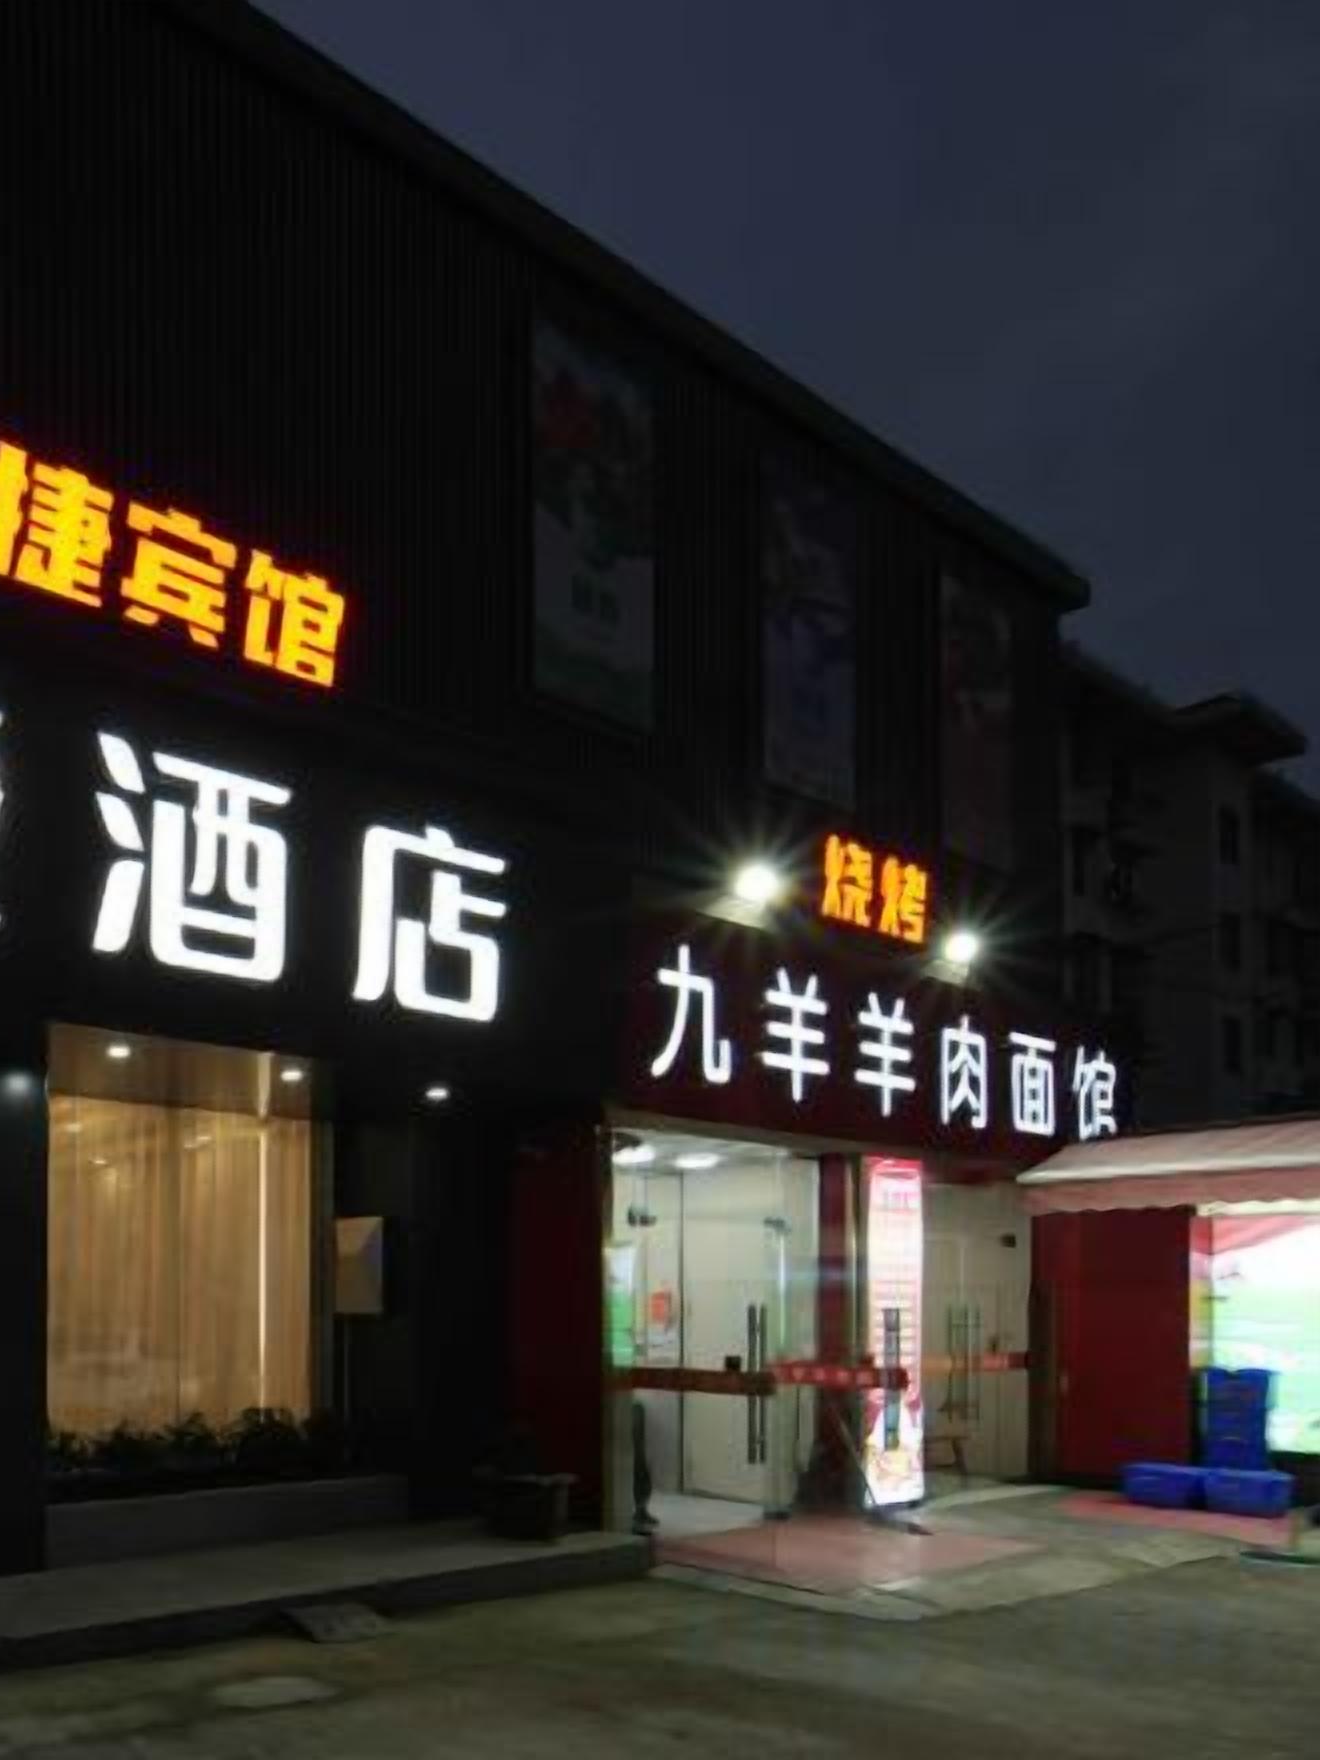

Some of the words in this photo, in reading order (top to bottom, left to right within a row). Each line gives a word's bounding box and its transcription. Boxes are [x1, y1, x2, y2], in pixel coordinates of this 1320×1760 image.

[821, 834, 929, 944] 烧烤
[650, 944, 1118, 1140] 九羊羊肉面馆
